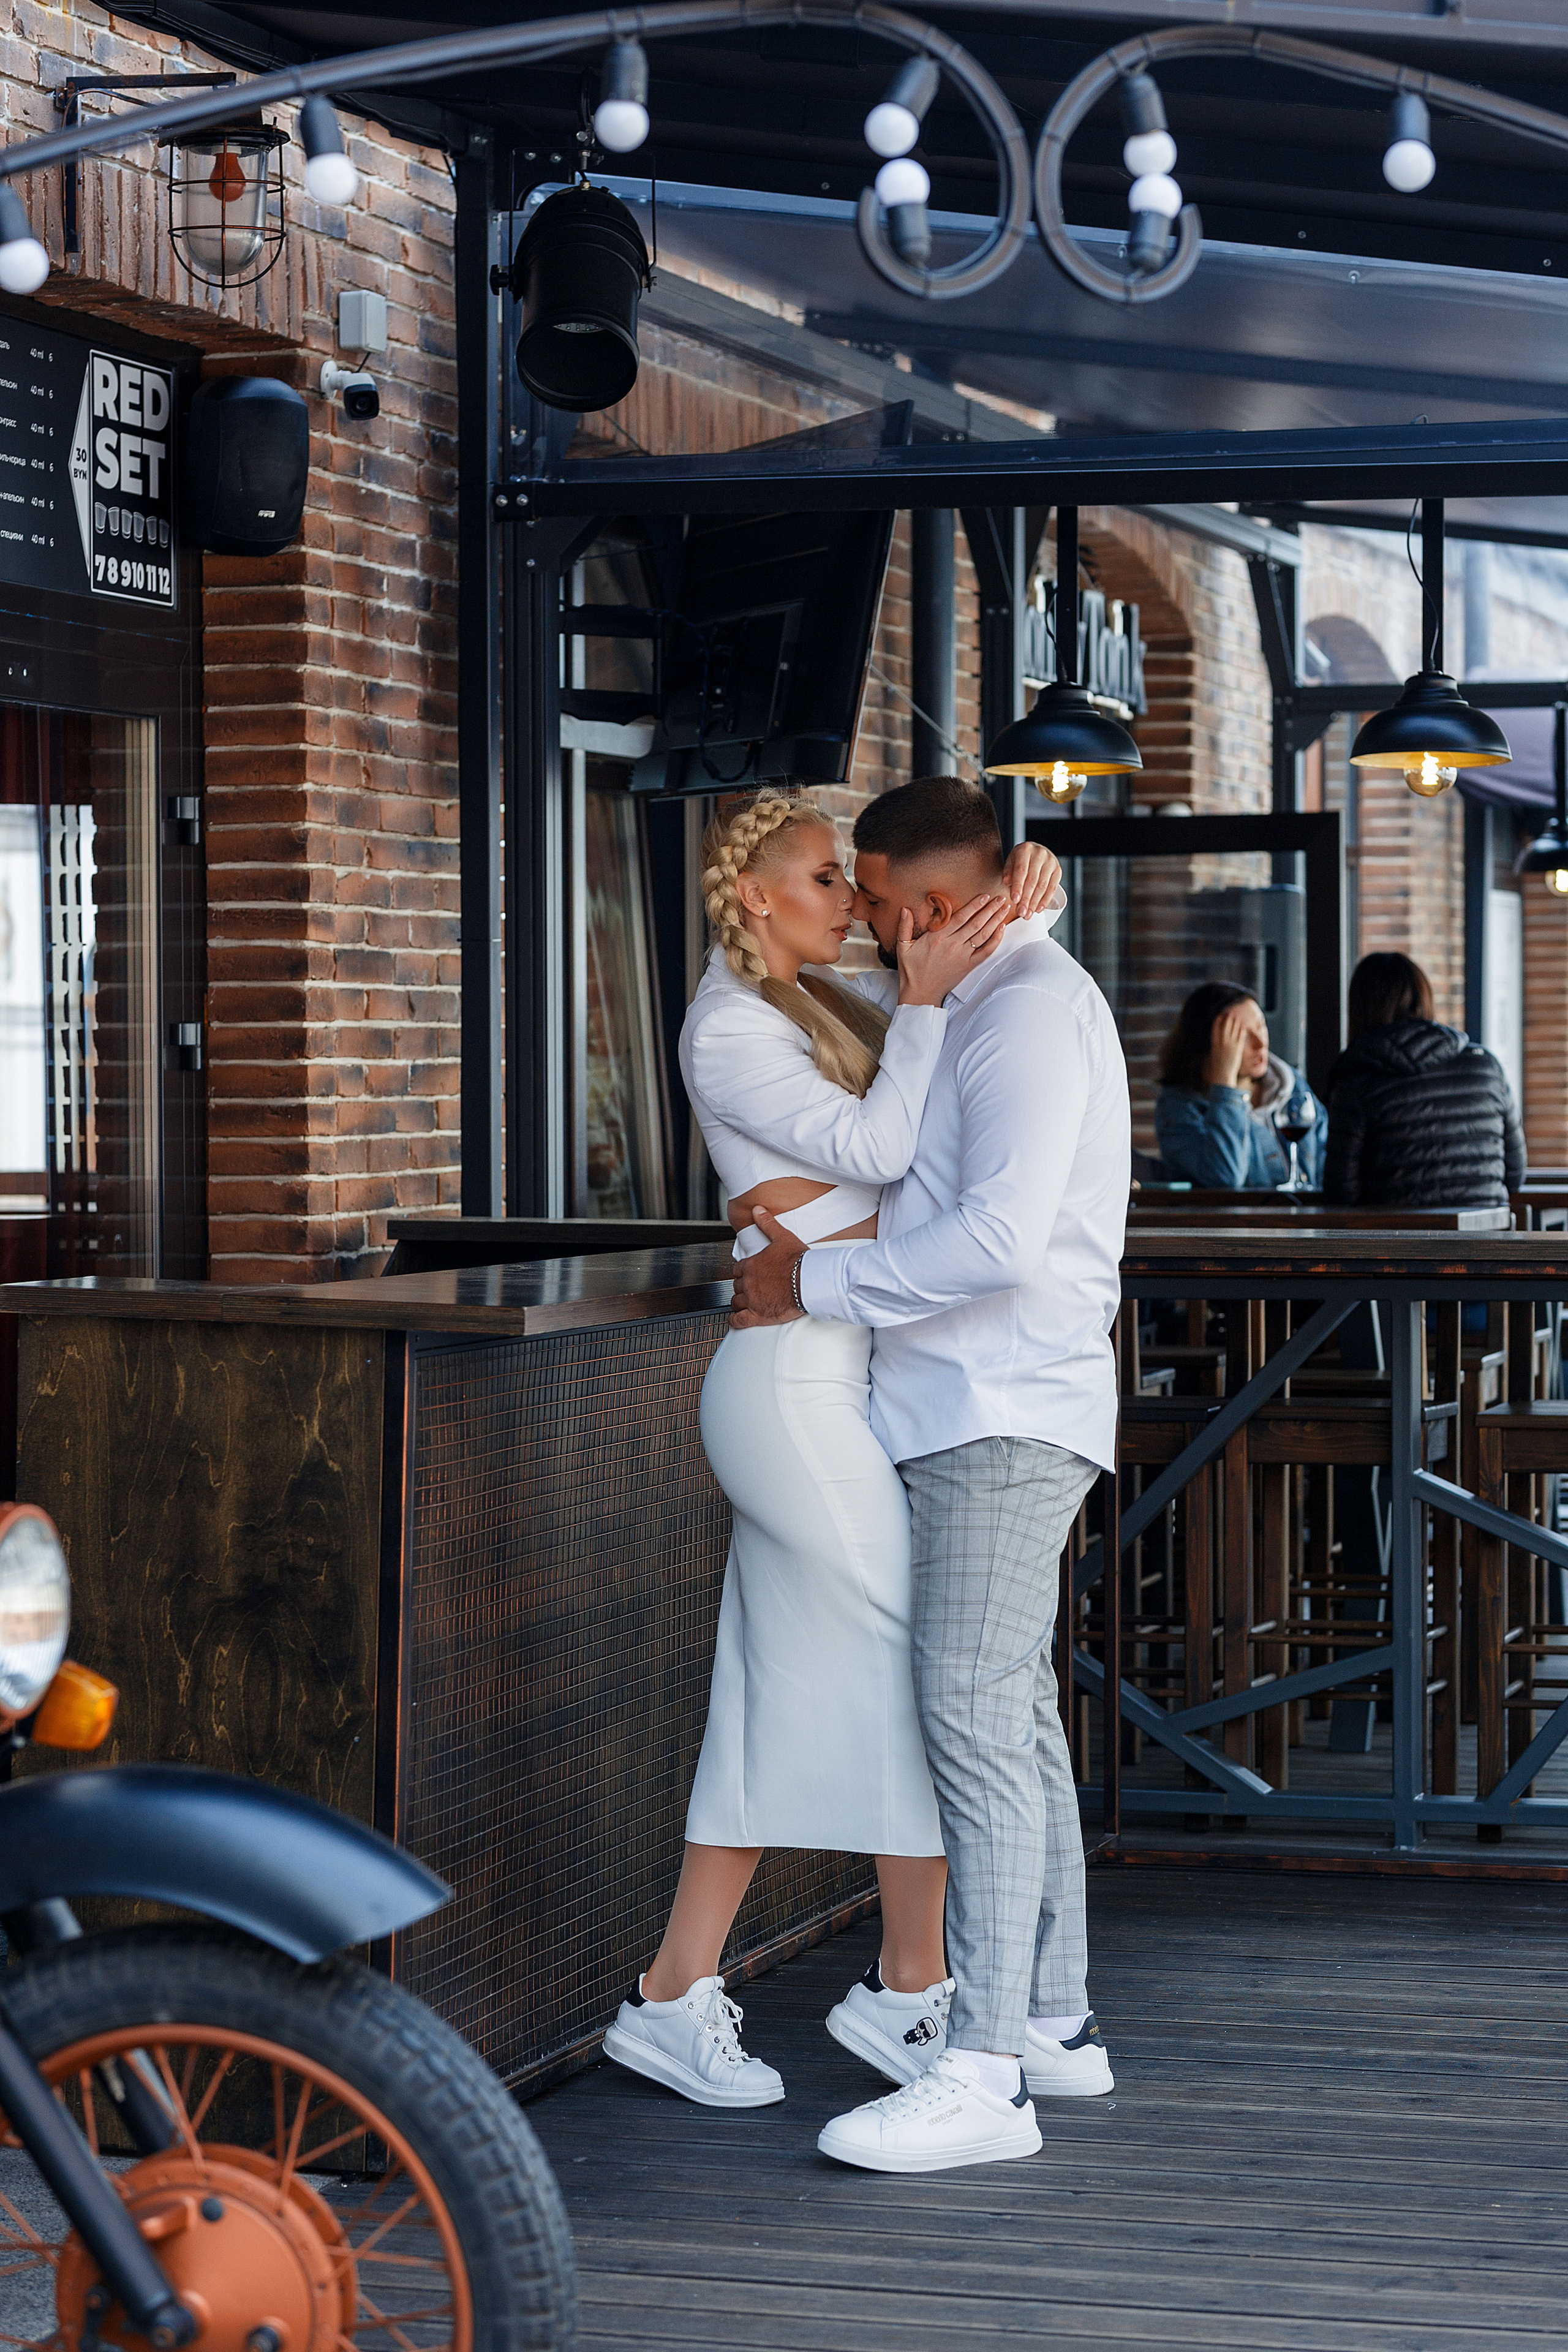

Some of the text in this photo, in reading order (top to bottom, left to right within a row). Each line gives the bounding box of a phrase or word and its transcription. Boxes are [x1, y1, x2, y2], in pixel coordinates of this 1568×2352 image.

[30, 349, 37, 357] 40
[37, 350, 44, 359] ml
[30, 385, 37, 394] 40
[38, 387, 44, 396] ml
[49, 390, 53, 399] 6
[94, 356, 170, 431] RED
[30, 423, 37, 432] 40
[38, 425, 45, 434] ml
[50, 428, 54, 436] 6
[76, 448, 86, 462] 30
[31, 459, 37, 468] 40
[38, 461, 45, 469] ml
[50, 463, 54, 472] 6
[96, 428, 165, 499] SET
[74, 468, 87, 480] BYN
[31, 497, 37, 506] 40
[39, 499, 45, 507] ml
[50, 501, 54, 510] 6
[31, 535, 37, 543] 40
[37, 535, 45, 545] ml
[50, 538, 55, 546] 6
[95, 554, 170, 595] 7 8 9 10 11 12
